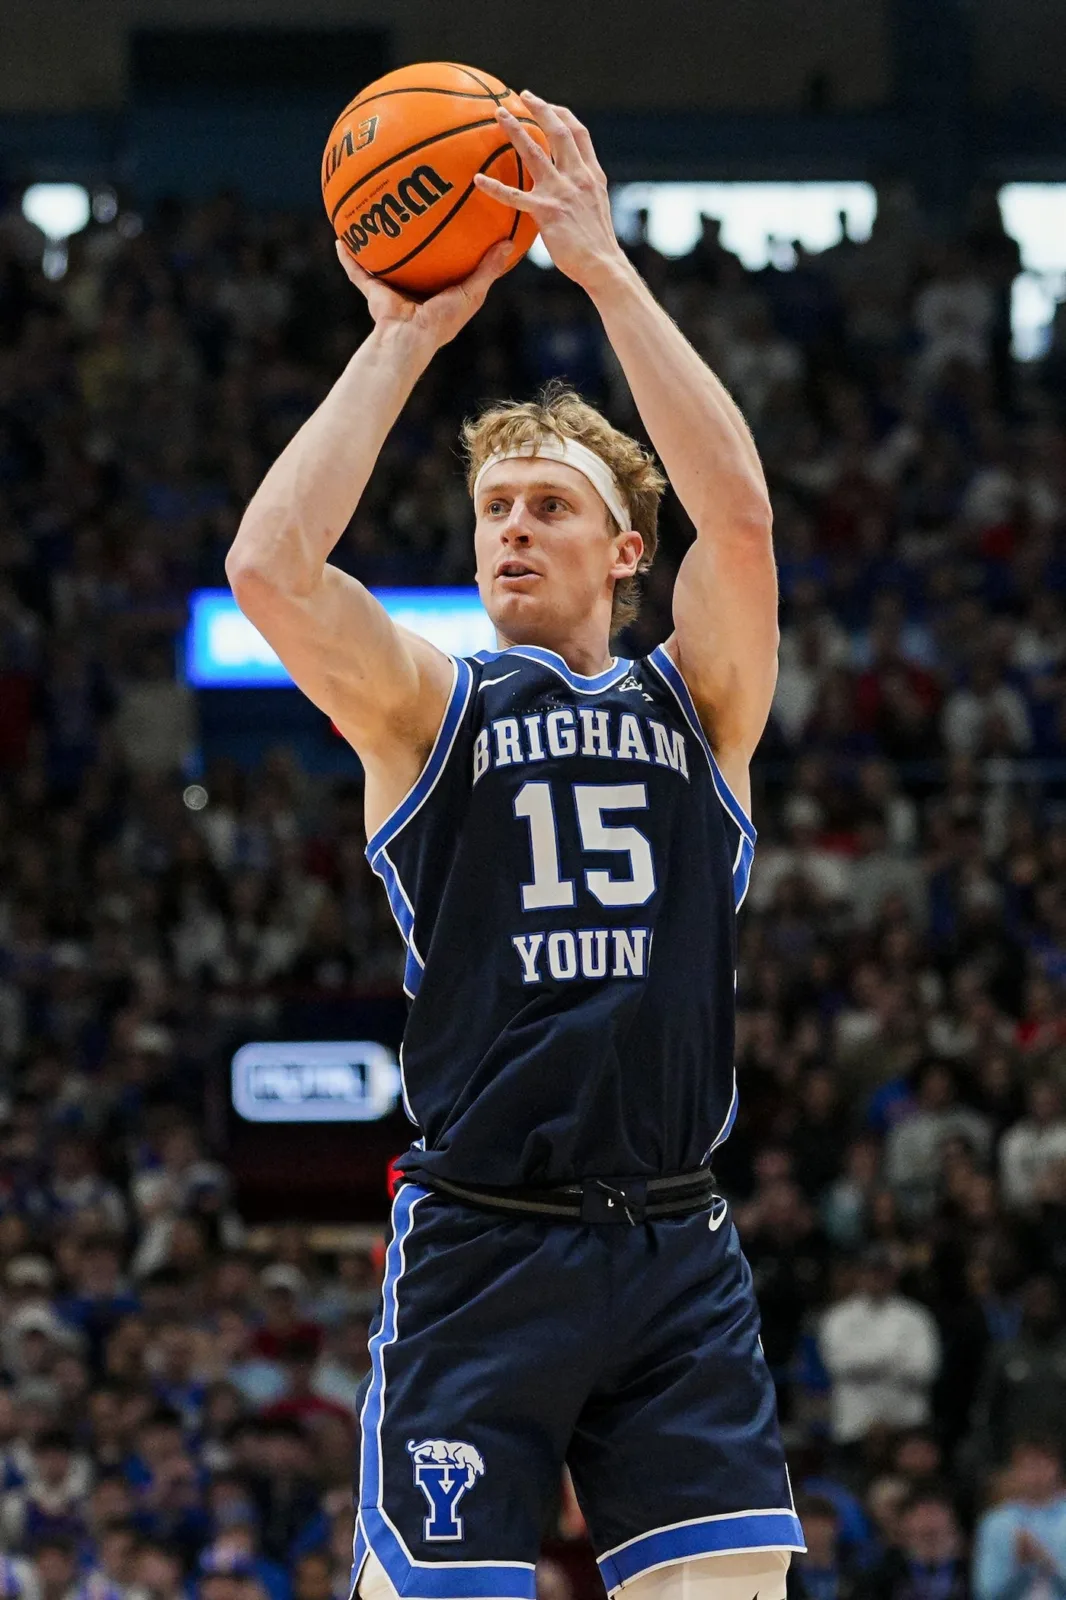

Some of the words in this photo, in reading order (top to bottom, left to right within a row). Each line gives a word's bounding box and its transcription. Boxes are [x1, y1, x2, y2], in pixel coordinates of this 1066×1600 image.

[341, 165, 454, 254] Wilson
[473, 708, 690, 787] BRIGHAM
[513, 780, 657, 911] 15
[511, 927, 653, 983] YOUN
[415, 1464, 469, 1541] Y
